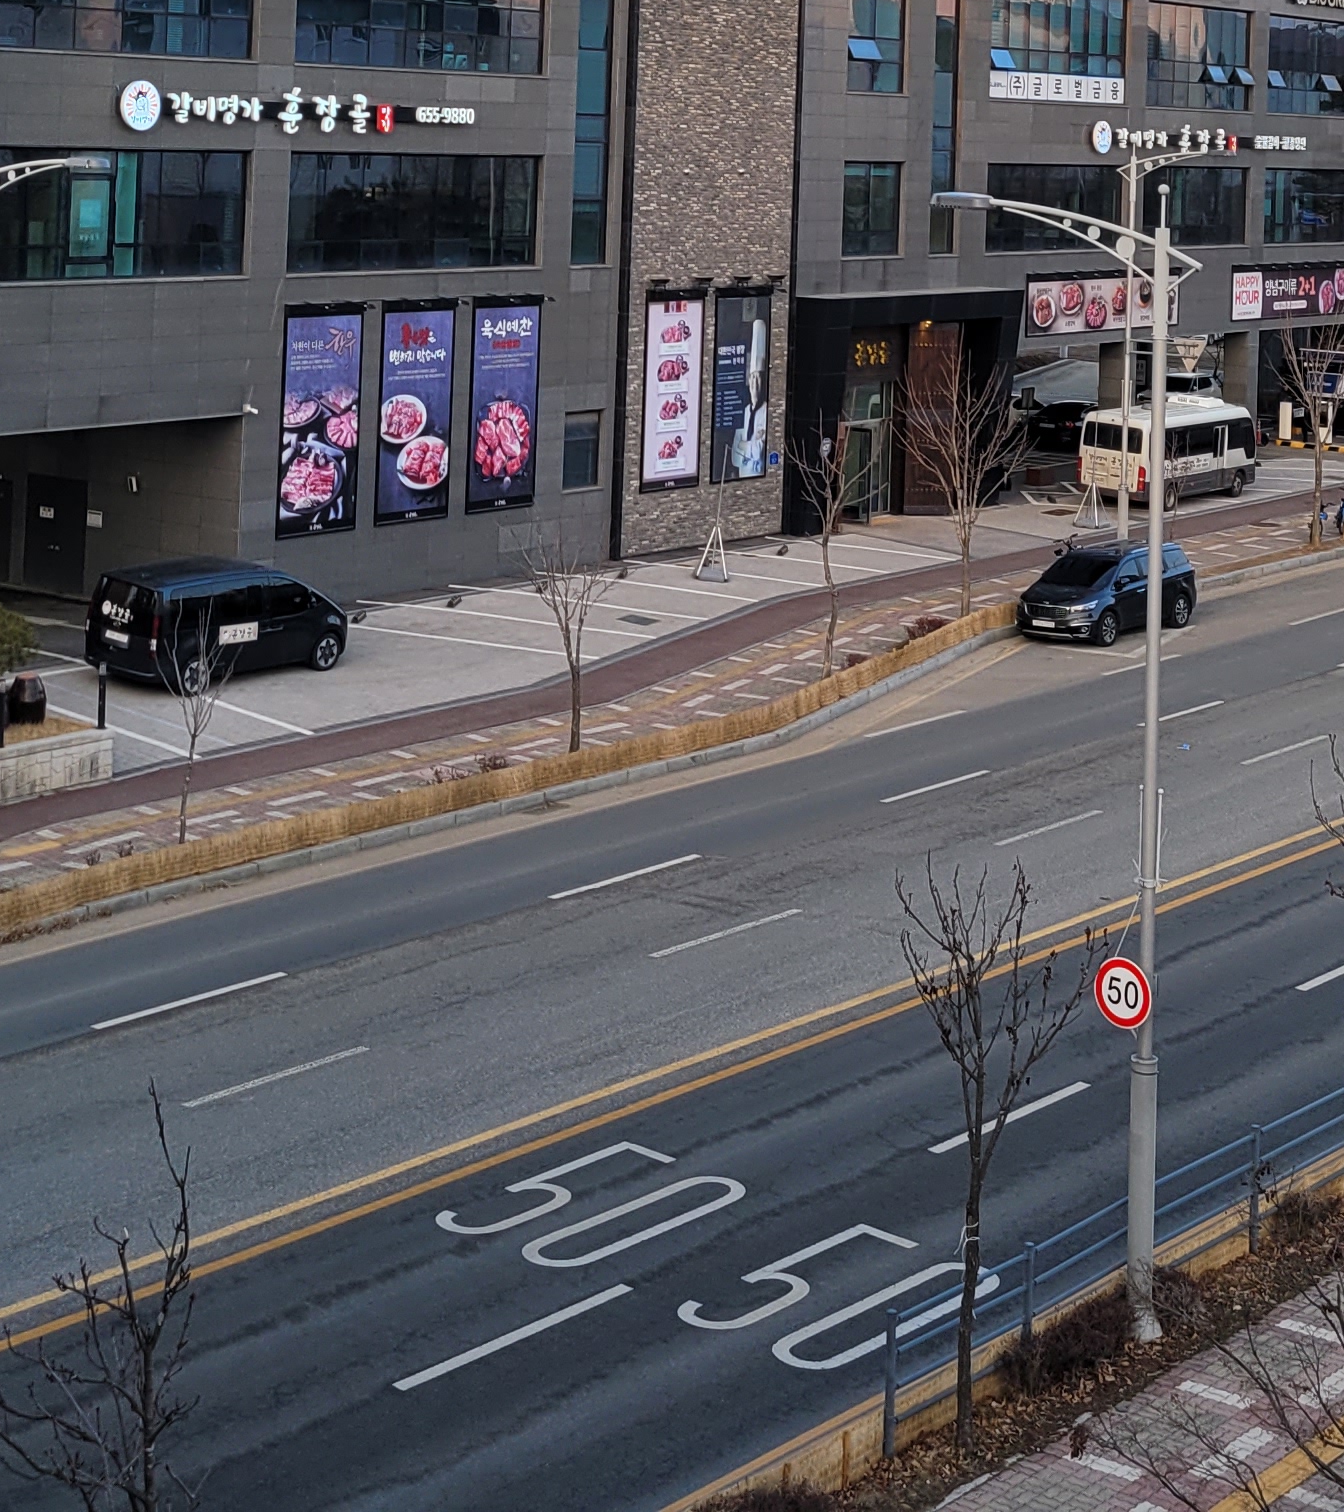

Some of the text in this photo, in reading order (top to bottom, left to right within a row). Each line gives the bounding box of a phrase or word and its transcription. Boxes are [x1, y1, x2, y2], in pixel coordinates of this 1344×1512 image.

[166, 91, 264, 126] 갈비명가
[278, 87, 371, 135] 훈장골
[415, 106, 476, 125] 655-9880
[1235, 275, 1260, 289] HAPPY
[1298, 275, 1316, 296] 2+1
[1235, 289, 1260, 306] HOUR
[480, 315, 533, 340] 육식예찬
[1106, 976, 1140, 1010] 50
[434, 1140, 747, 1268] 50
[676, 1223, 1001, 1371] 50
